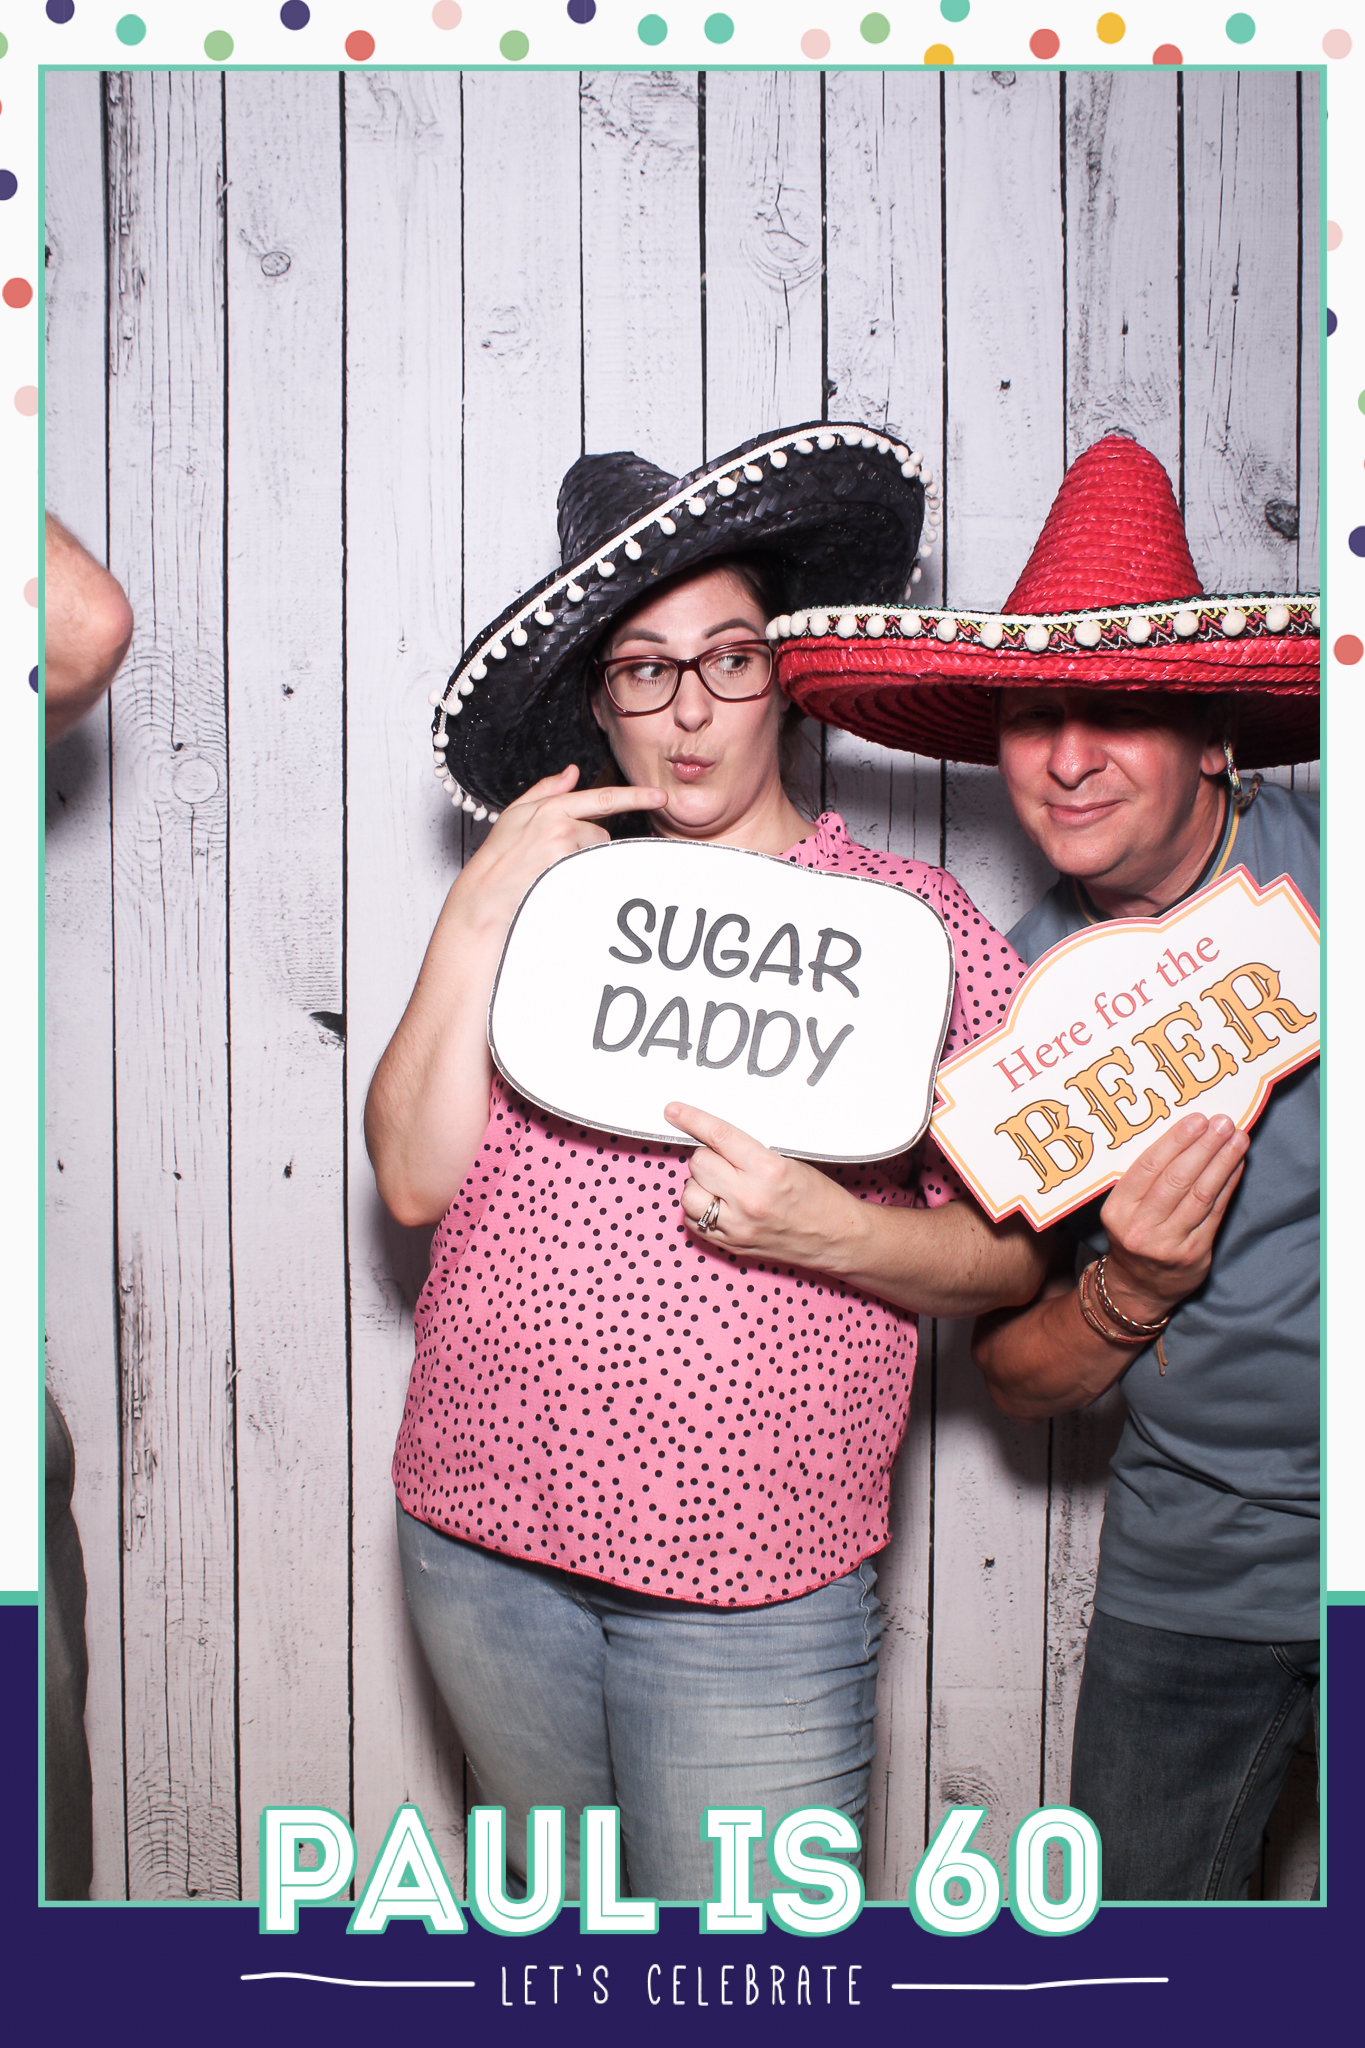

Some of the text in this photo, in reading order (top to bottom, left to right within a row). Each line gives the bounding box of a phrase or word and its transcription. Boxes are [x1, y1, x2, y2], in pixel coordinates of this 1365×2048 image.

[608, 897, 862, 999] SUGAR
[592, 983, 855, 1088] DADDY
[992, 936, 1221, 1093] Here for the
[994, 961, 1318, 1195] BEER
